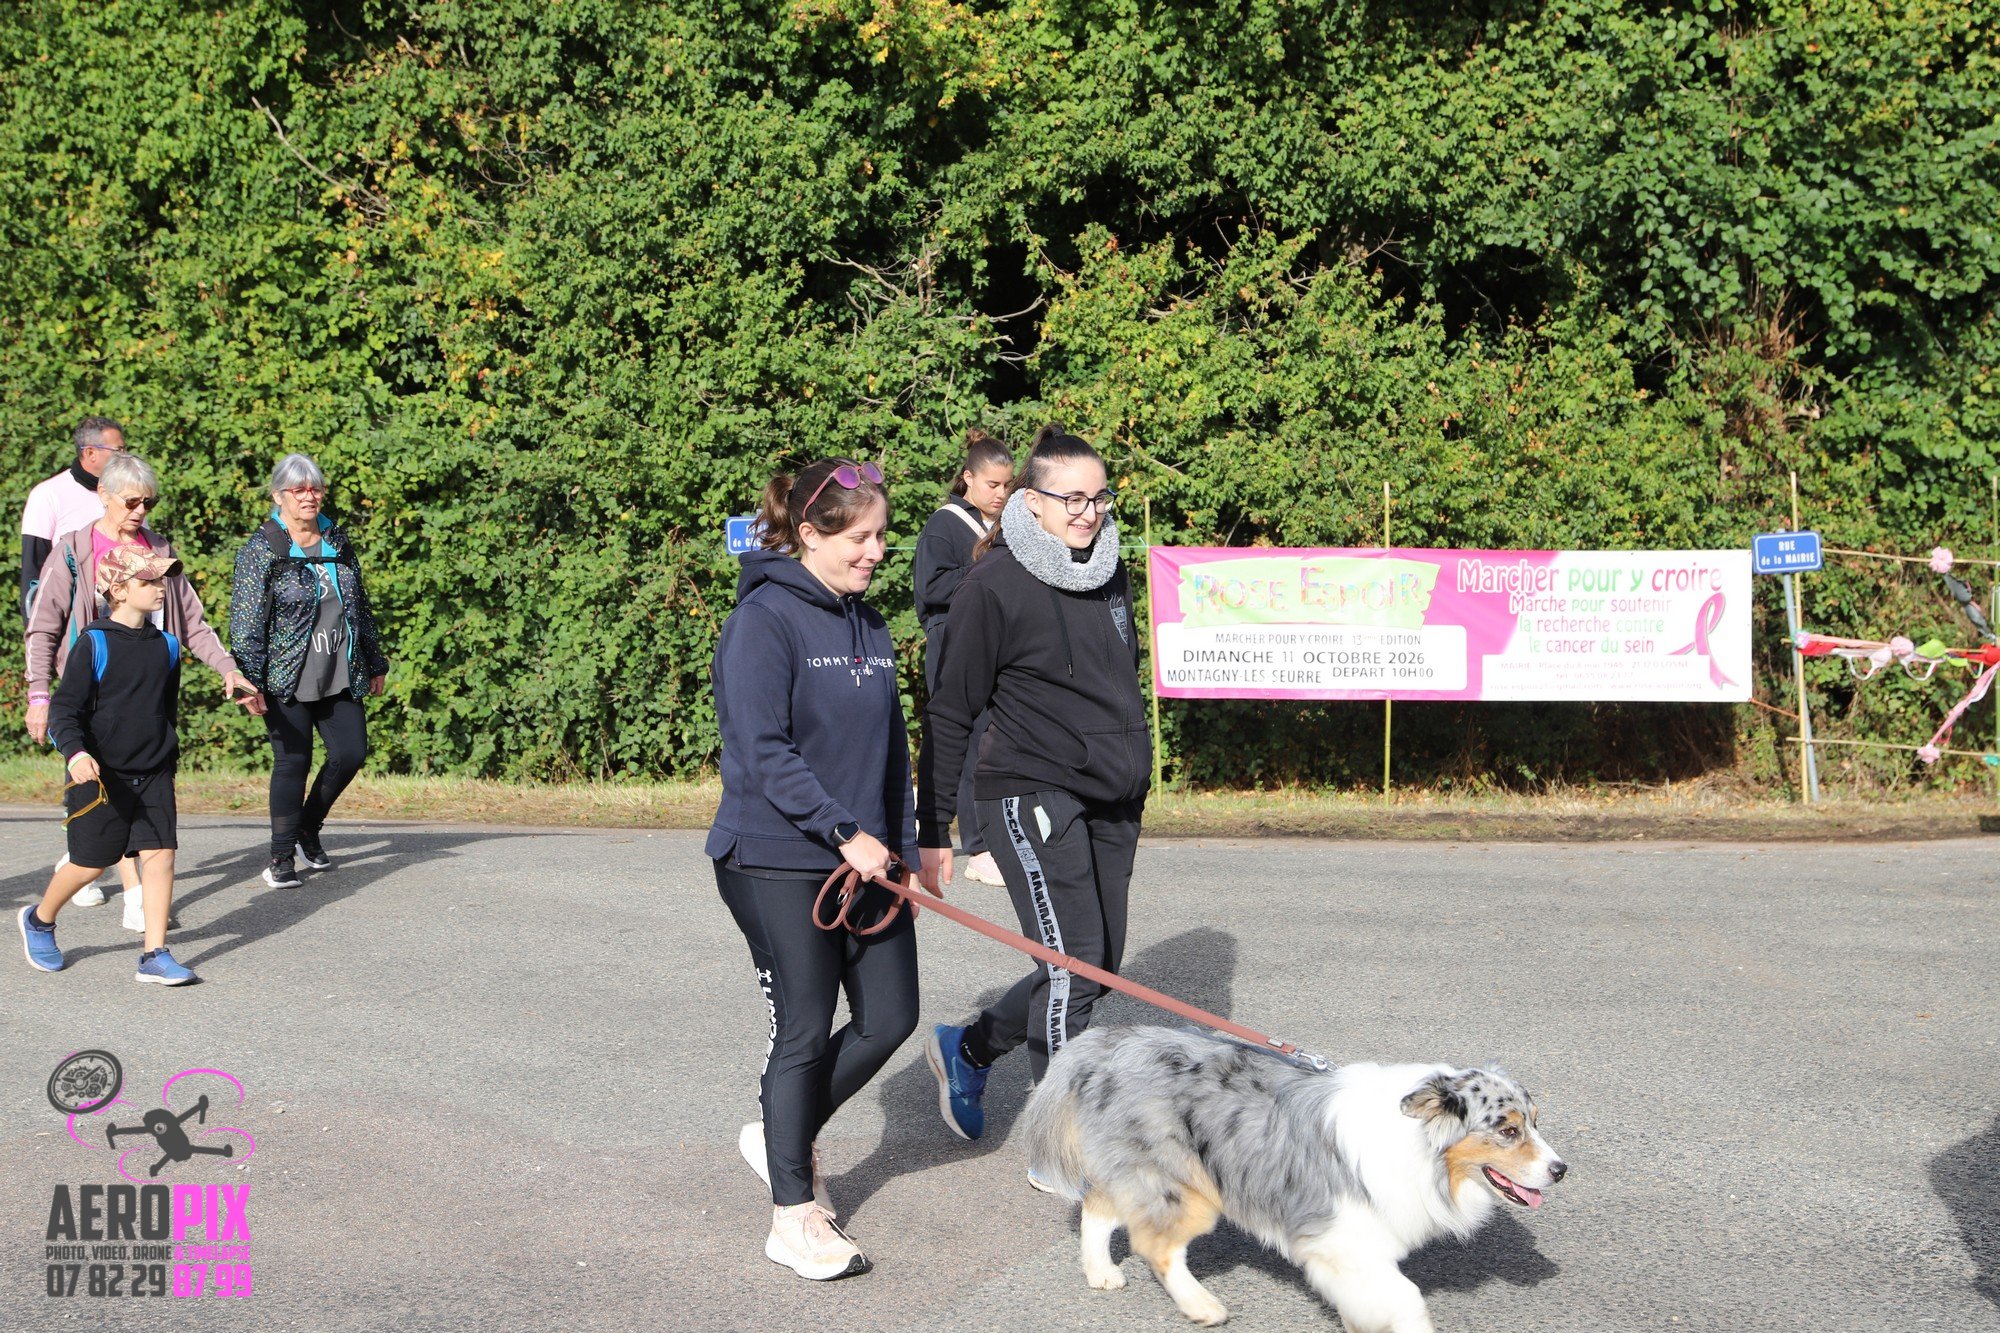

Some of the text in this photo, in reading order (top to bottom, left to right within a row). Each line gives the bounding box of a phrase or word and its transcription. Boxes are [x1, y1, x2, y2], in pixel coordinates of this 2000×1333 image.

[1778, 540, 1796, 551] RUE
[1761, 552, 1816, 566] de la MAIRIE
[1458, 558, 1722, 592] Marcher pour y croire
[1511, 594, 1673, 612] Marche pour soutenir
[1519, 615, 1665, 632] la recherche contre
[1215, 633, 1265, 645] MARCHER
[1269, 633, 1297, 645] POUR
[1299, 634, 1306, 645] Y
[1308, 634, 1344, 646] CROIRE
[1380, 634, 1421, 646] EDITION
[1529, 635, 1654, 653] le cancer du sein
[806, 656, 849, 668] TOMMY
[1183, 650, 1425, 664] DIMANCHE 11 OCTOBRE 2026
[1332, 667, 1434, 678] DEPART 10H00
